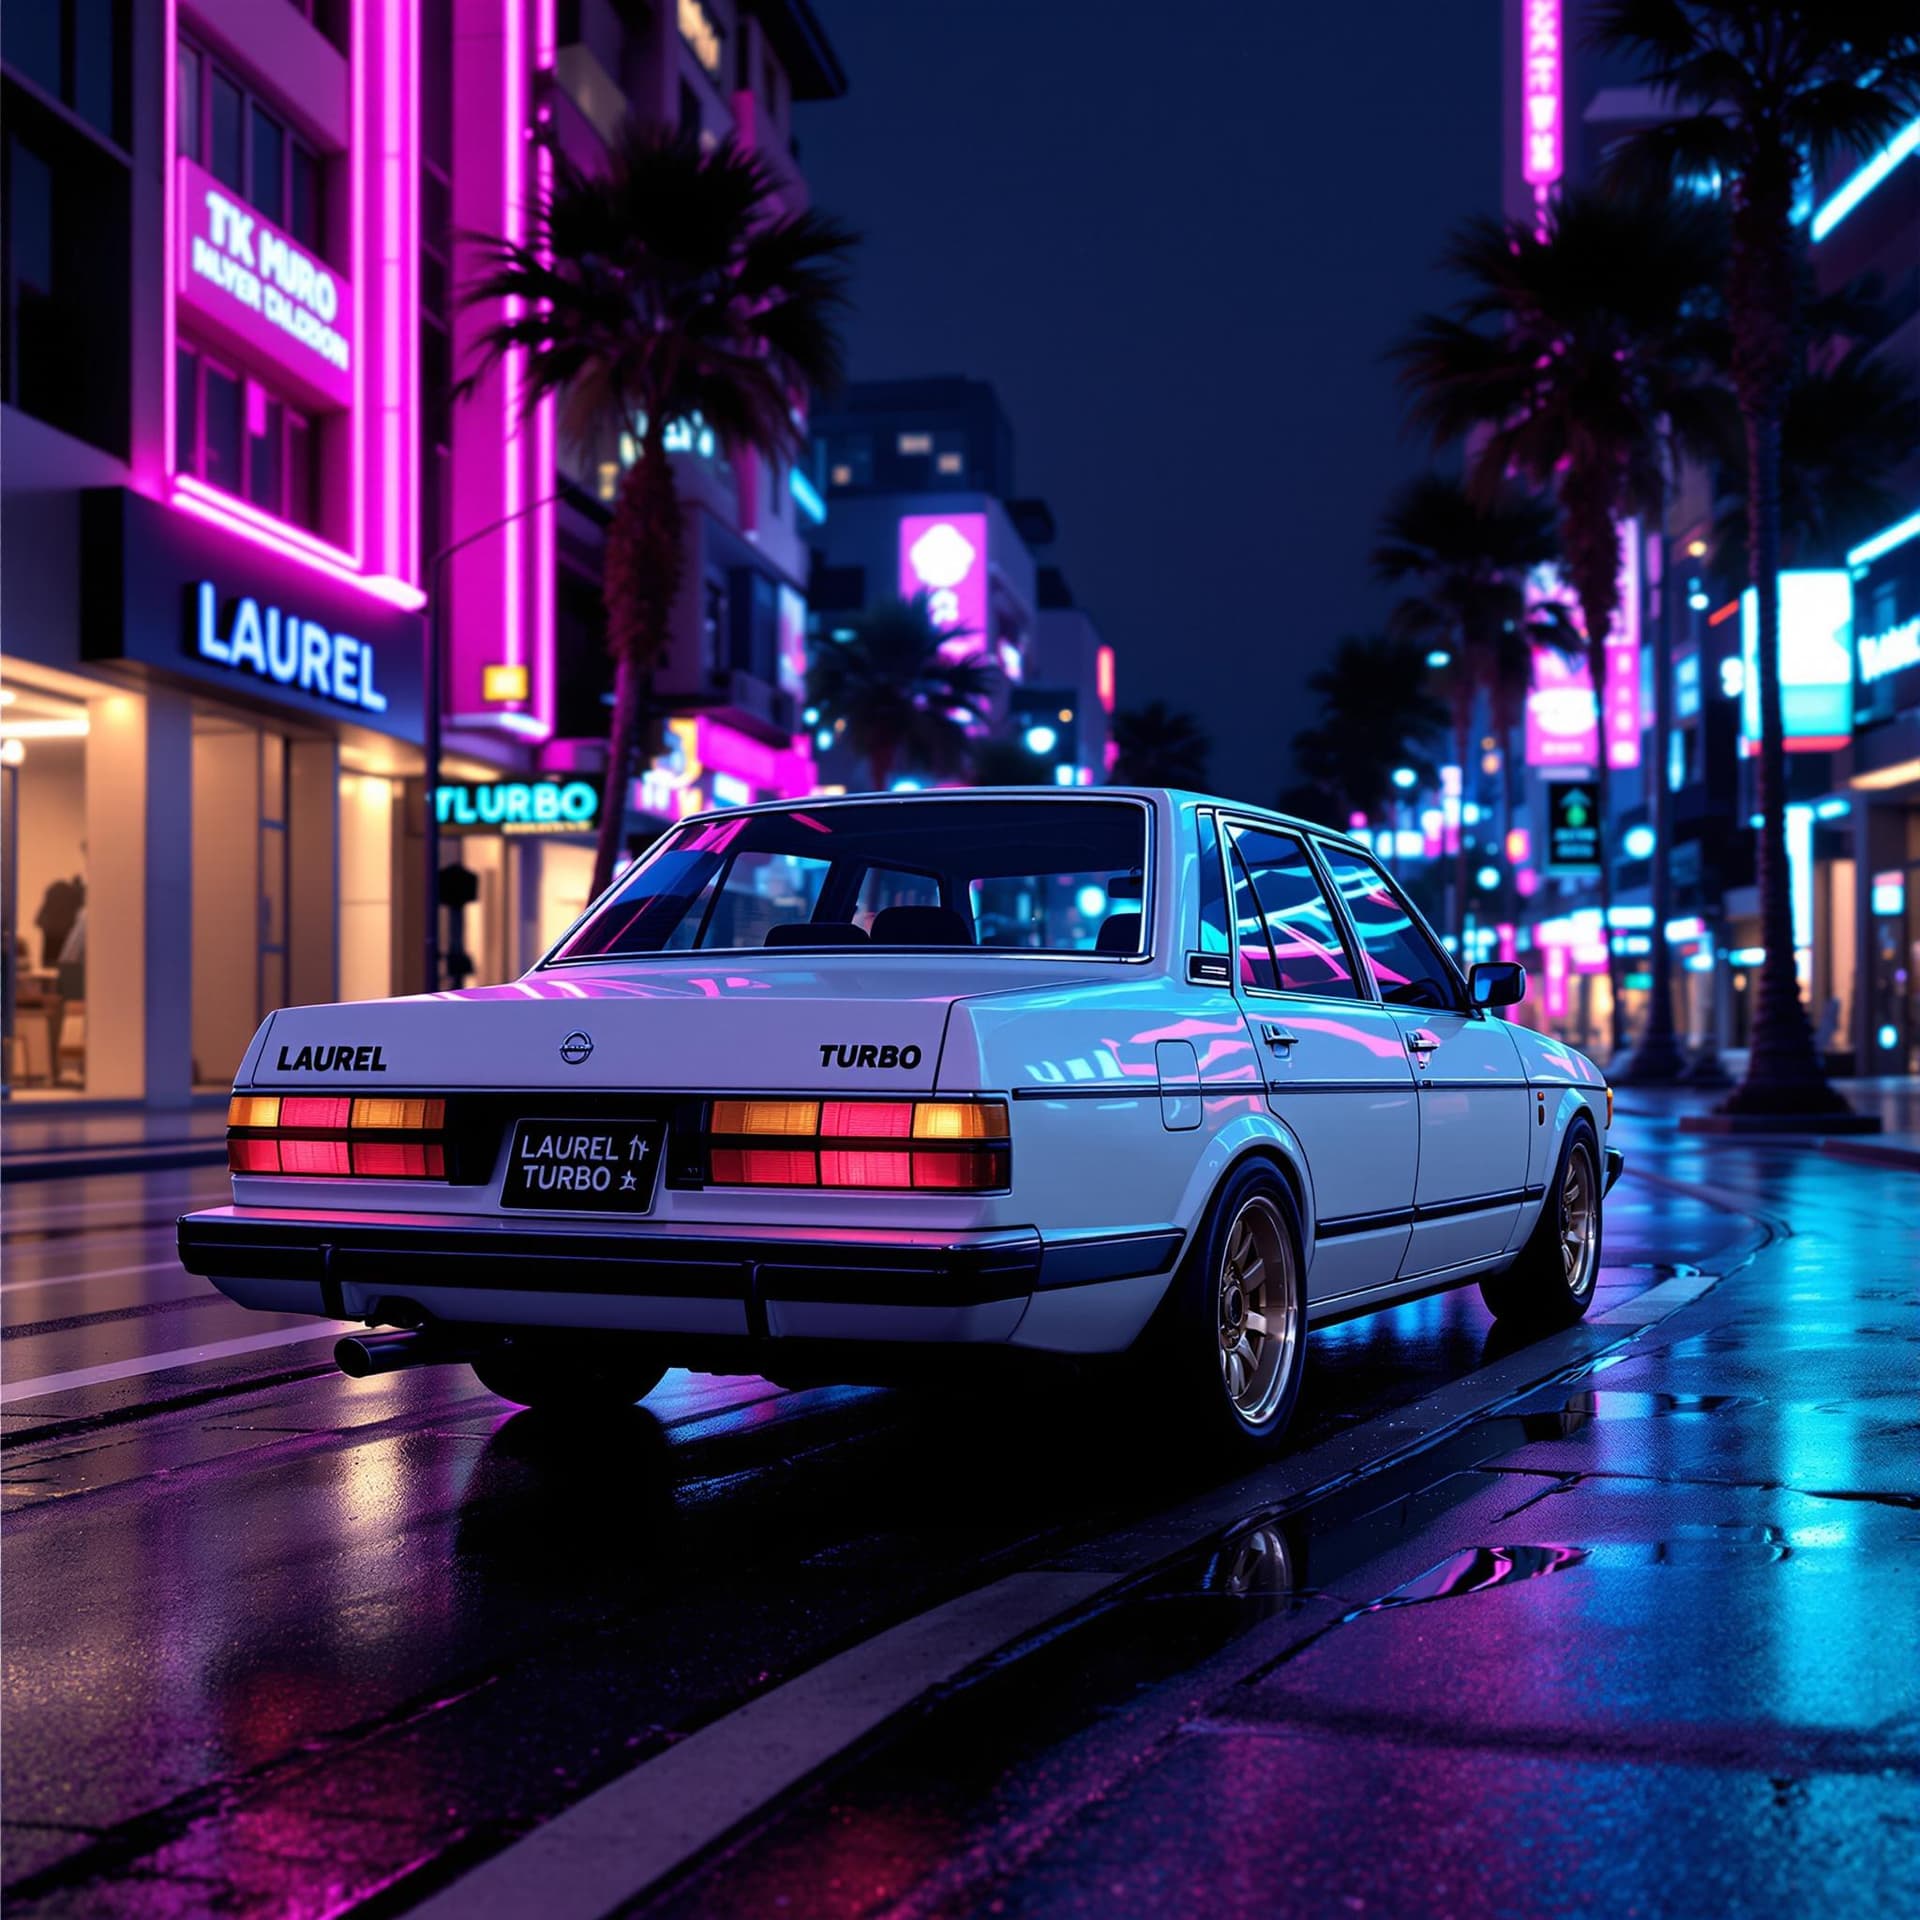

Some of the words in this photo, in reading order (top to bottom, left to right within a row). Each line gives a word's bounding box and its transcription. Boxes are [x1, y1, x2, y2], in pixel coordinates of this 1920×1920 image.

[197, 581, 387, 713] LAUREL
[277, 1046, 386, 1071] LAUREL
[819, 1044, 922, 1069] TURBO
[521, 1135, 619, 1161] LAUREL
[523, 1165, 611, 1191] TURBO
